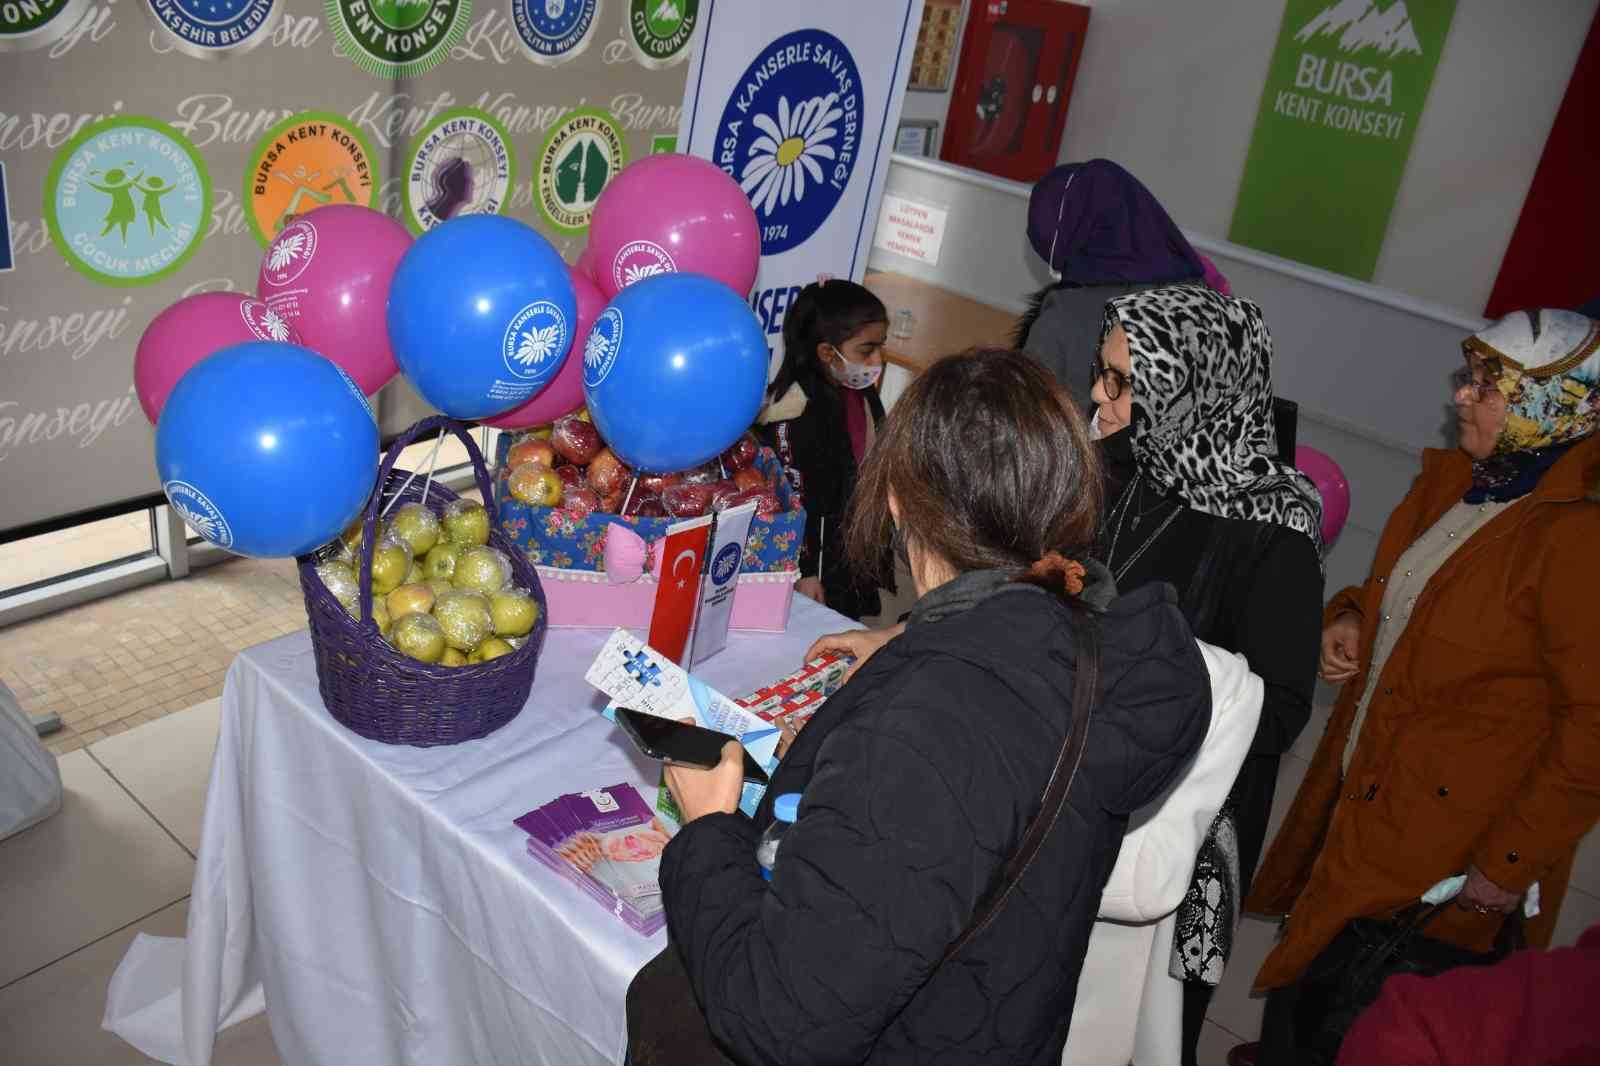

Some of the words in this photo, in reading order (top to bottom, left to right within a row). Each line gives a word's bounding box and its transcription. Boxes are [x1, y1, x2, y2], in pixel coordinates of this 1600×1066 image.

[634, 11, 651, 45] CITY
[650, 15, 694, 53] COUNCIL
[1295, 53, 1393, 107] BURSA
[720, 120, 743, 176] URSA
[736, 42, 811, 114] KANSERLE
[1274, 90, 1322, 123] KENT
[1323, 103, 1406, 140] KONSEYİ
[63, 149, 96, 208] BURSA
[97, 132, 145, 152] KENT
[254, 142, 287, 195] BURSA
[287, 125, 327, 144] KENT
[331, 128, 371, 187] KONSEYİ
[411, 134, 440, 182] BURSA
[442, 120, 475, 136] KENT
[543, 131, 568, 174] BURSA
[569, 118, 596, 133] KENT
[762, 224, 788, 241] 1974
